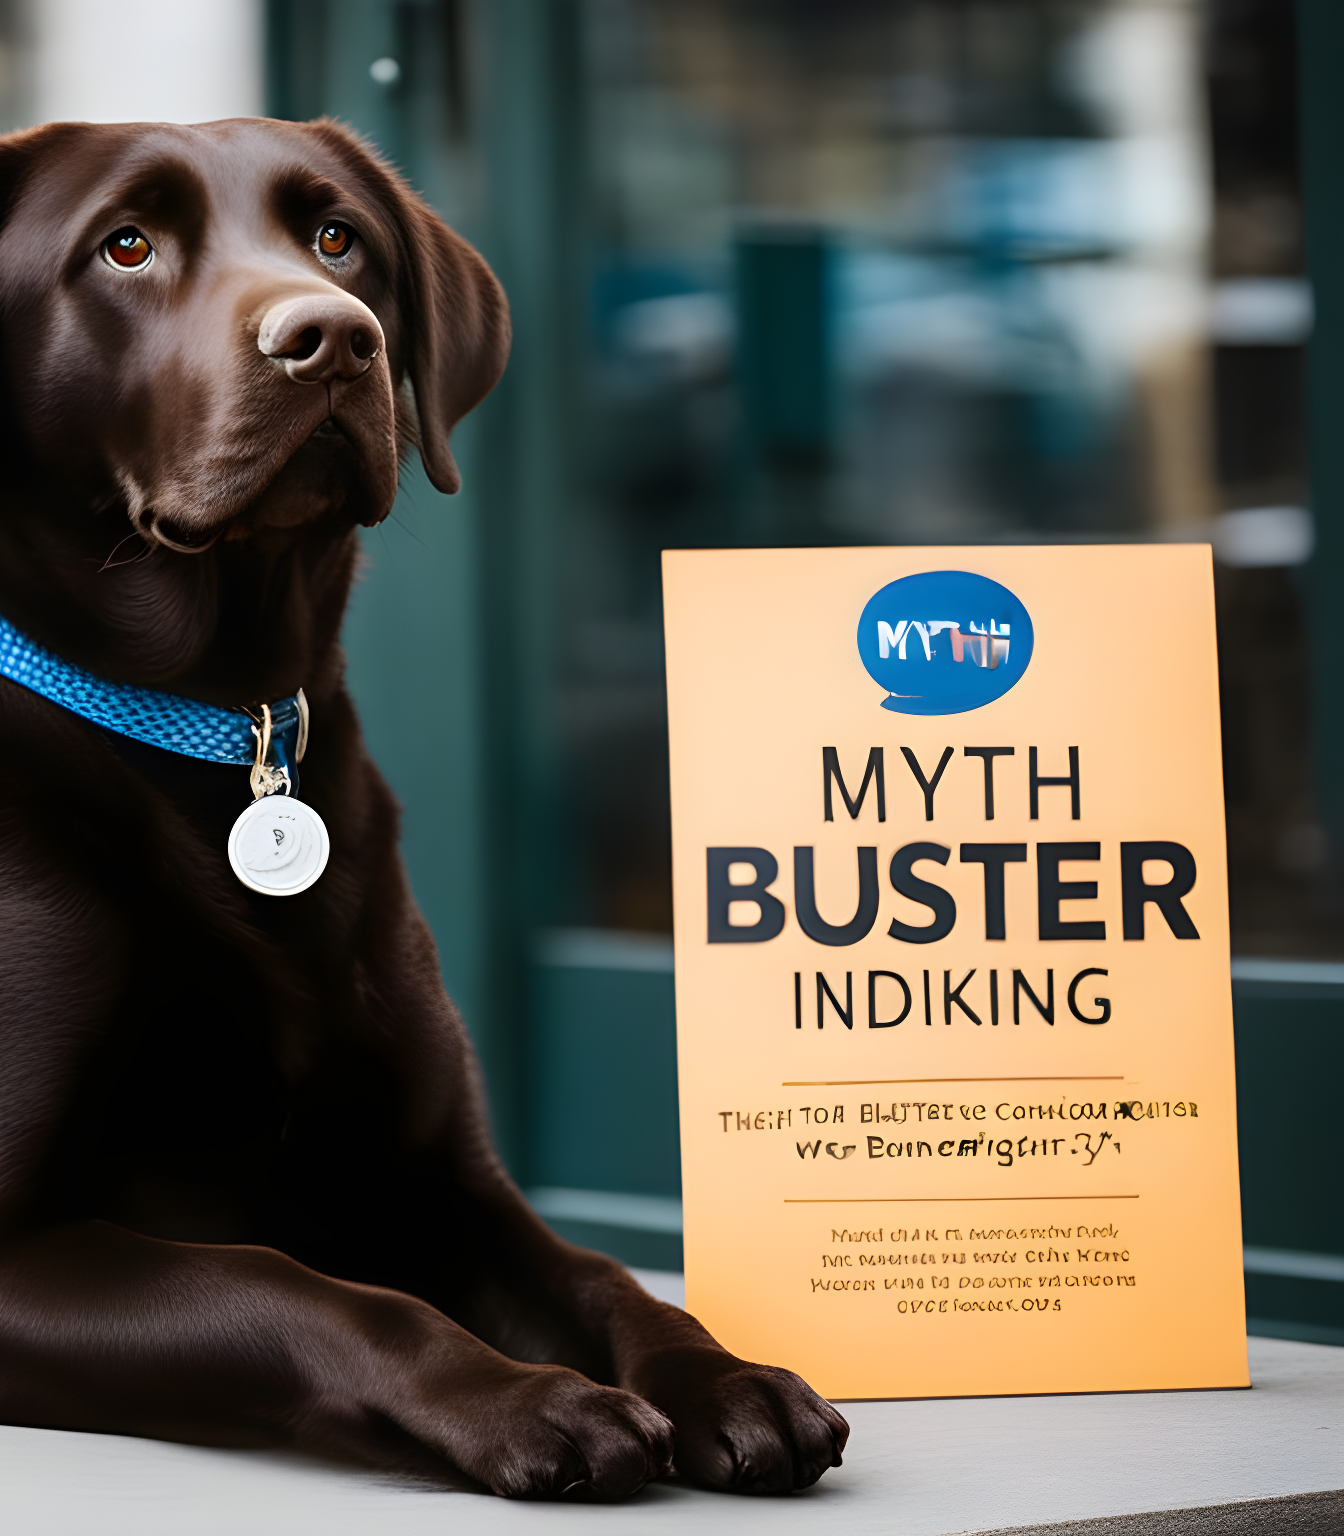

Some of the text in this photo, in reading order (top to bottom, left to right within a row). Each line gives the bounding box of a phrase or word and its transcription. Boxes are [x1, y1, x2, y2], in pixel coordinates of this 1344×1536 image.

[822, 746, 1081, 822] MYTH
[706, 840, 1201, 946] BUSTER
[794, 967, 1111, 1030] INDIKING
